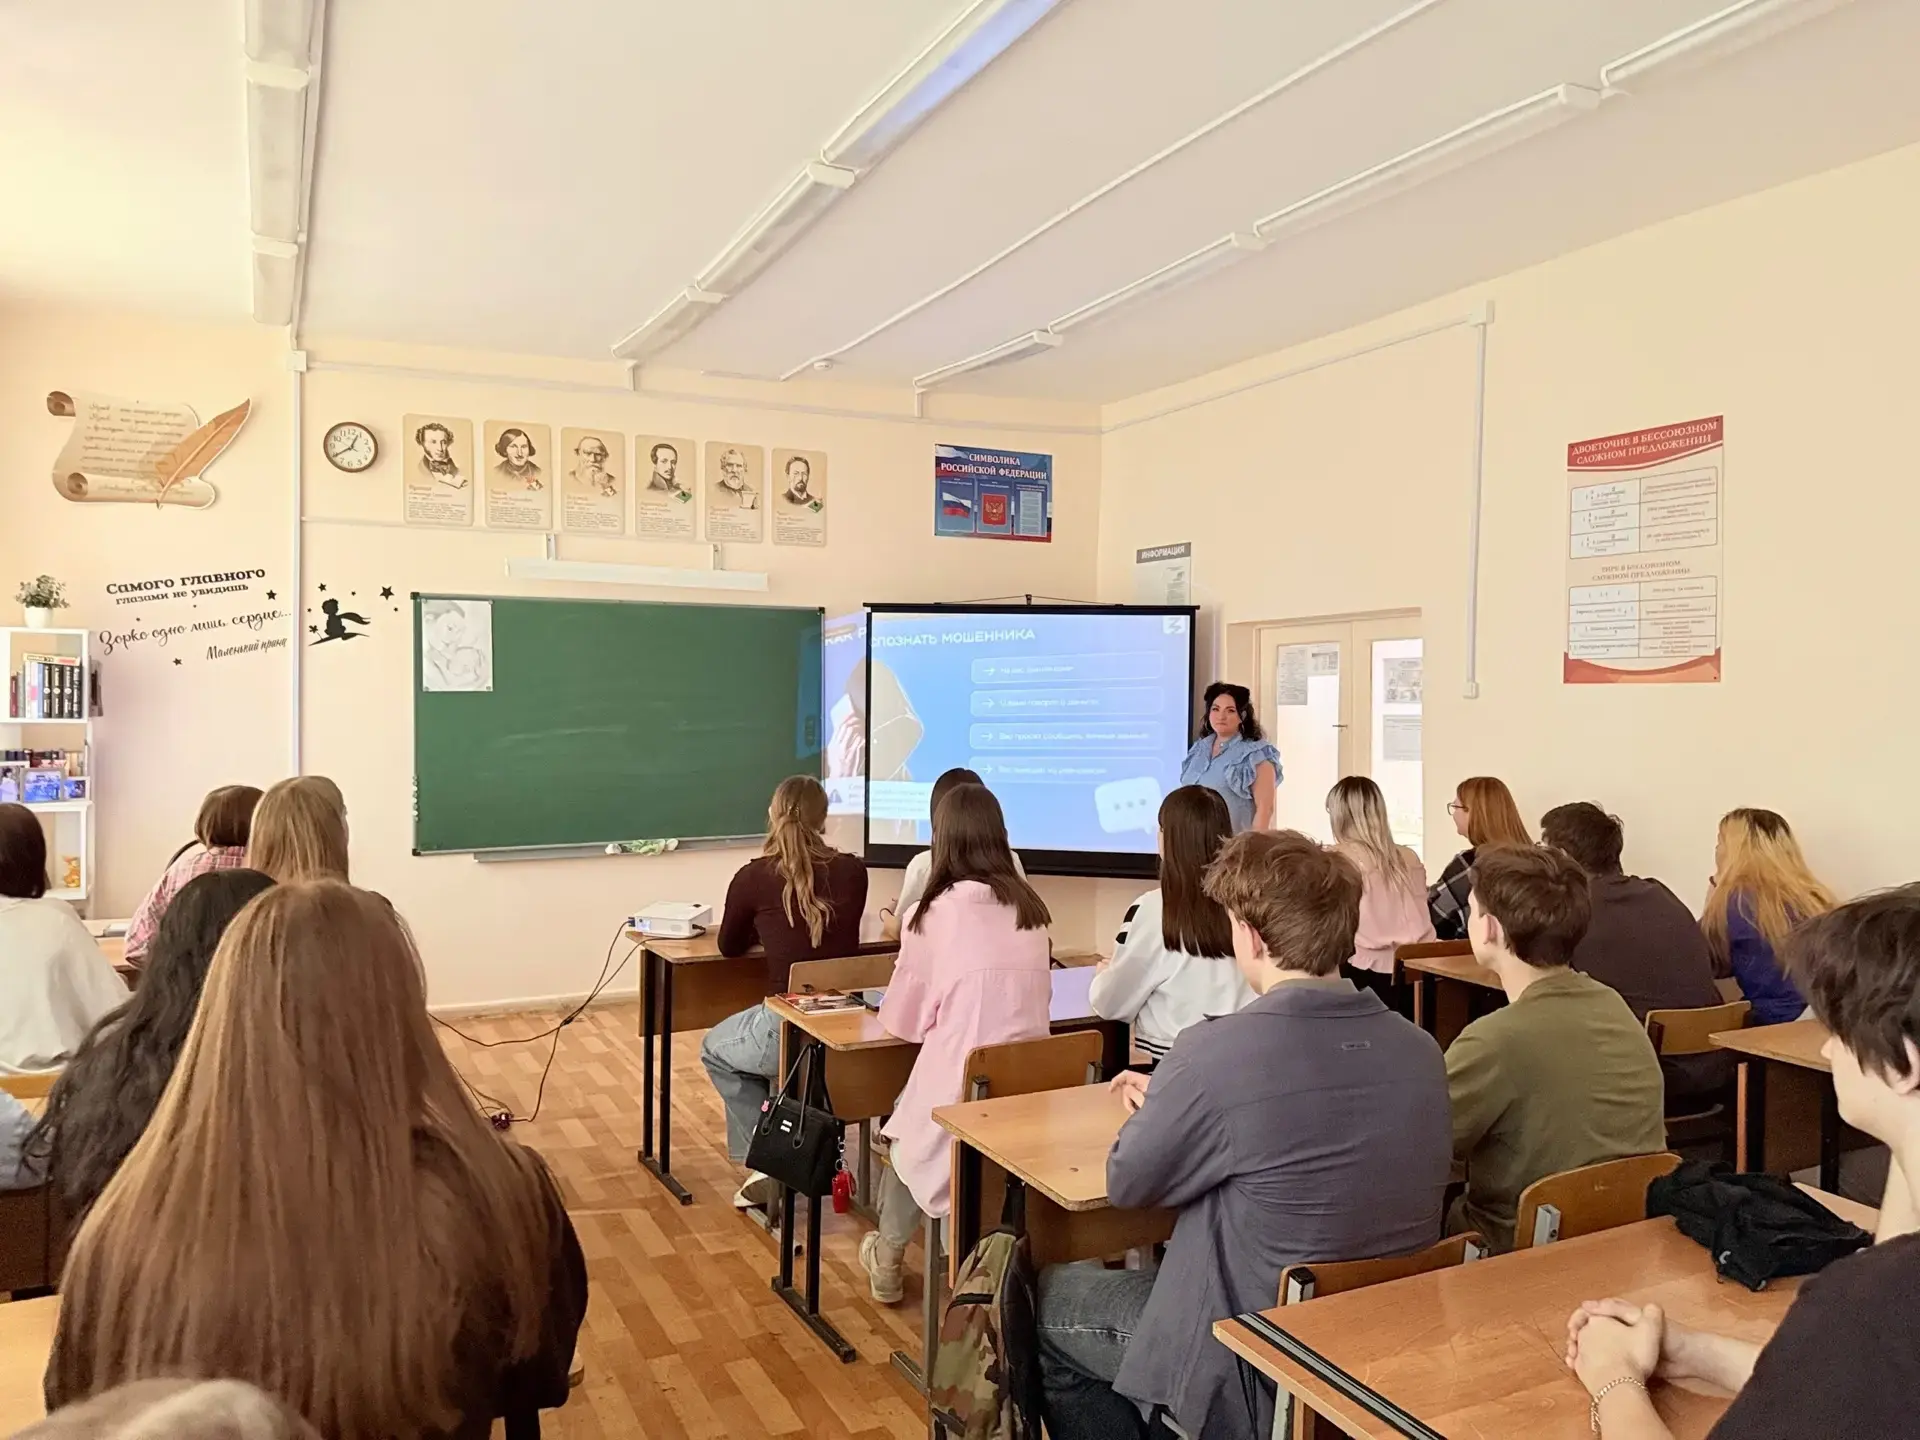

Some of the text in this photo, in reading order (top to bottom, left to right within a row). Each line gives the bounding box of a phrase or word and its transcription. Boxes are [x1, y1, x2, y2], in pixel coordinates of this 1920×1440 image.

[1632, 436, 1639, 445] В
[1641, 421, 1718, 442] БЕССОЮЗНОМ
[969, 453, 1021, 466] СИМВОЛИКА
[1576, 434, 1711, 464] СЛОЖНОМ ПРЕДЛОЖЕНИИ
[941, 463, 1047, 480] РОССИЙСКОЙ ФЕДЕРАЦИИ
[1141, 545, 1185, 559] ИНФОРМАЦИЯ
[106, 568, 266, 595] Самого главного
[116, 583, 249, 605] глазами не увидишь
[99, 629, 149, 656] Зорко
[152, 625, 188, 647] одно
[190, 618, 228, 633] лишь
[942, 628, 1035, 644] МОШЕННИКА
[206, 637, 288, 660] Маленький принц
